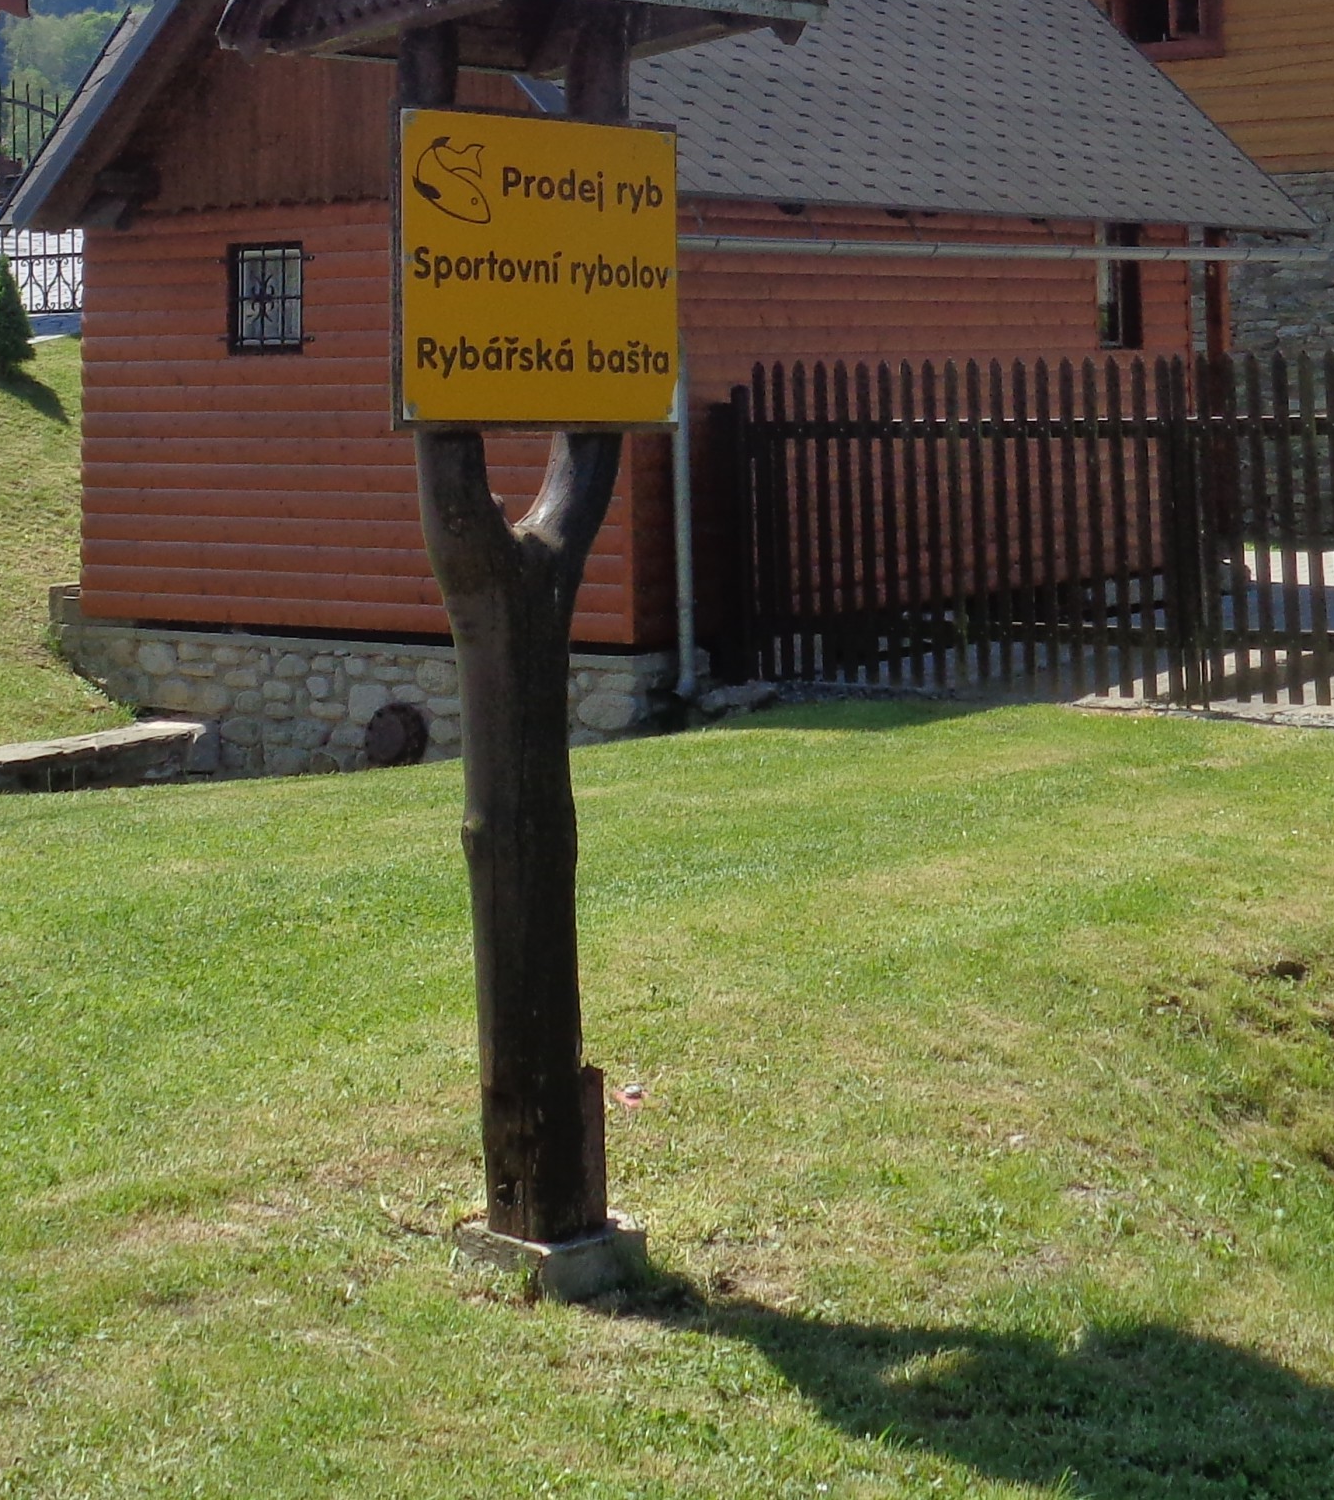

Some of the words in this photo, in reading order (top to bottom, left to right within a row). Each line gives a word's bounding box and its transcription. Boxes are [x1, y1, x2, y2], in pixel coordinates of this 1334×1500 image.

[502, 166, 604, 212] Prodej
[616, 175, 663, 214] ryb
[413, 246, 563, 288] Sportovní
[570, 253, 669, 294] rybolov
[417, 335, 574, 379] Rybářská
[587, 339, 670, 375] bašta
